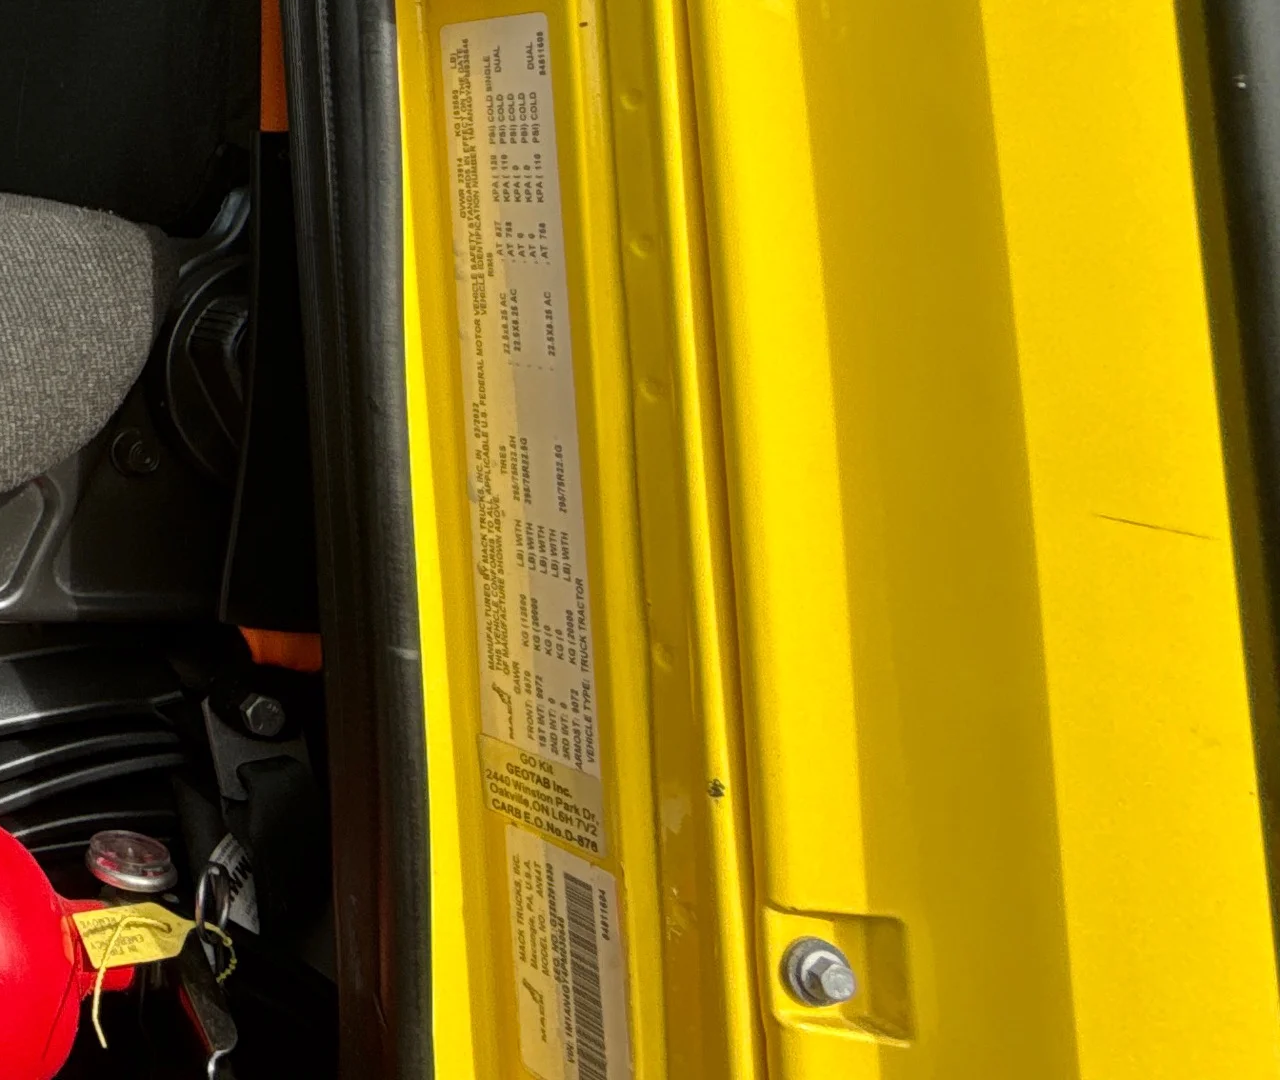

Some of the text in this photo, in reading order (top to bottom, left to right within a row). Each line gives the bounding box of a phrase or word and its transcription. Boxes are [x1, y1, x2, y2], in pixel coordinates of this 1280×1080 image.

[455, 47, 464, 74] DATE
[492, 45, 502, 73] DUAL
[524, 41, 534, 70] DUAL
[482, 54, 492, 92] SINGLE
[459, 97, 466, 113] ON
[485, 94, 494, 122] COLD
[495, 93, 505, 122] COLD
[528, 91, 538, 120] COLD
[453, 122, 461, 137] KG
[460, 115, 469, 153] EFFECT
[487, 124, 496, 144] PSI)
[498, 123, 507, 144] PSI)
[531, 122, 540, 143] PSI)
[463, 155, 470, 165] IN
[468, 144, 478, 187] NUMBER
[458, 187, 466, 218] GVWR
[463, 168, 474, 228] STANDARDS
[491, 180, 499, 201] KPA
[501, 180, 510, 202] KPA
[534, 180, 544, 203] KPA
[472, 189, 484, 269] IDENTIFICATION
[467, 231, 477, 269] SAFETY
[495, 241, 503, 255] AT
[506, 242, 514, 256] AT
[539, 244, 548, 258] AT
[470, 272, 480, 315] VEHICLE
[477, 271, 487, 315] VEHICLE
[499, 291, 507, 306] AC
[509, 287, 517, 303] AC
[543, 290, 552, 306] AC
[474, 318, 483, 356] MOTOR
[476, 358, 486, 406] FEDERAL
[474, 448, 482, 460] IN
[481, 430, 492, 495] APPLICABLE
[485, 252, 521, 696] GAWR TIRES RIMS
[485, 498, 493, 517] ALL
[486, 519, 494, 534] TO
[513, 517, 523, 546] WITH
[525, 521, 534, 550] WITH
[479, 532, 489, 564] MACK
[494, 534, 504, 574] SHOWN
[515, 548, 524, 567] LB)
[559, 530, 569, 560] WITH
[487, 537, 498, 598] CONFORMS
[527, 551, 536, 571] LB)
[561, 561, 571, 582] LB)
[482, 582, 495, 671] MANUFACTURED
[491, 599, 501, 645] VEHICLE
[497, 576, 509, 658] MANUFACTURE
[520, 630, 529, 647] KG
[532, 634, 541, 652] KG
[494, 647, 503, 672] THIS
[502, 658, 510, 675] OF
[567, 646, 576, 665] KG
[574, 576, 595, 764] VEHICLE TYPE: TRUCK TRACTOR
[525, 698, 535, 740] FRONT:
[538, 726, 547, 749] 1ST
[572, 715, 584, 771] ARMOST:
[520, 753, 554, 775] GO Kit
[506, 763, 572, 799] GEOTAB Inc.
[485, 769, 599, 826] 2440 Winston Park Dr.
[492, 798, 521, 819] CARB
[552, 810, 573, 827] L6H
[575, 818, 598, 837] 7V2
[513, 876, 524, 925] TRUCKS,
[517, 927, 526, 963] MACK
[539, 934, 549, 976] MODEL
